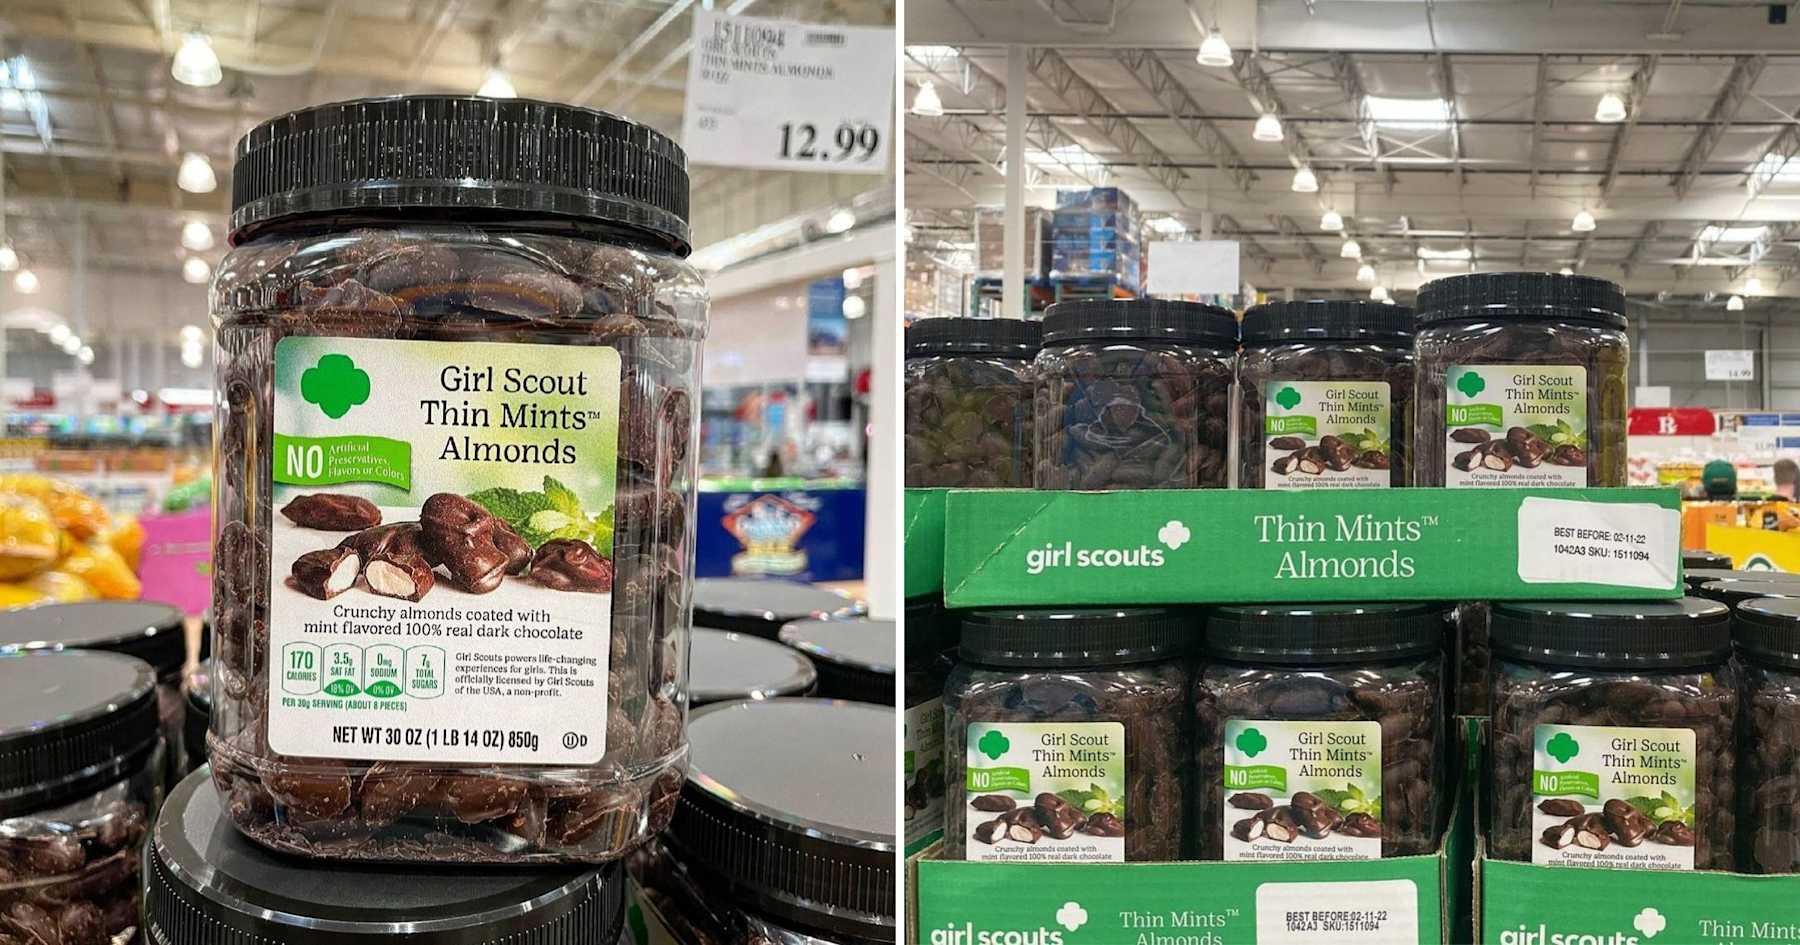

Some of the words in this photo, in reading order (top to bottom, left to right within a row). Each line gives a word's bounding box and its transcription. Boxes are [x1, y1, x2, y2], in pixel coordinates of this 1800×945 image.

[780, 122, 880, 162] 12.99
[440, 365, 492, 392] Girl
[503, 368, 587, 396] Scout
[1513, 375, 1535, 386] Girl
[1539, 375, 1573, 386] Scout
[1326, 389, 1345, 399] Girl
[1348, 390, 1379, 400] Scout
[1505, 389, 1534, 400] Thin
[420, 400, 489, 427] Thin
[1319, 402, 1344, 412] Thin
[1513, 403, 1570, 414] Almonds
[1326, 415, 1376, 424] Almonds
[1452, 408, 1467, 422] NO
[1271, 420, 1285, 431] NO
[329, 441, 369, 455] Artificial
[439, 437, 576, 464] Almonds
[287, 444, 323, 478] NO
[329, 455, 390, 466] Preservatives,
[329, 466, 360, 478] Flavors
[361, 467, 374, 475] or
[375, 467, 404, 480] Colors
[1254, 515, 1326, 542] Thin
[1554, 527, 1575, 538] BEST
[1578, 530, 1612, 541] BEFORE:
[1614, 533, 1646, 544] 02-11-22
[1027, 542, 1071, 575] girl
[1077, 544, 1165, 567] scouts
[1554, 544, 1586, 556] 1042A3
[1588, 547, 1610, 558] SKU:
[1613, 549, 1649, 561] 1511094
[1274, 550, 1415, 579] Almonds
[333, 605, 396, 621] Crunchy
[400, 606, 462, 621] almonds
[466, 608, 513, 622] coated
[516, 608, 551, 622] with
[304, 621, 338, 634] mint
[341, 620, 401, 635] flavored
[406, 623, 442, 637] 100%
[446, 624, 473, 637] real
[476, 624, 509, 638] dark
[514, 625, 583, 640] chocolate
[290, 651, 313, 669] 170
[377, 653, 392, 667] 0mg
[455, 652, 472, 661] Girl
[473, 653, 503, 662] Scouts
[504, 655, 537, 663] powers
[538, 654, 597, 666] life-changing
[330, 667, 342, 676] SAT
[344, 667, 355, 677] FAT
[370, 667, 397, 678] SODIUM
[416, 669, 434, 679] TOTAL
[455, 664, 508, 674] experiences
[510, 664, 522, 673] for
[524, 665, 546, 675] girls.
[548, 665, 568, 675] This
[570, 666, 577, 675] is
[287, 671, 317, 682] CALORIES
[455, 674, 494, 685] officially
[496, 675, 532, 684] licensed
[534, 676, 544, 687] by
[547, 677, 563, 686] Girl
[565, 677, 594, 686] Scouts
[411, 679, 438, 689] SUGARS
[455, 686, 464, 694] of
[466, 686, 480, 694] the
[483, 687, 504, 696] USA,
[514, 688, 562, 698] non-profit.
[282, 697, 296, 707] PER
[312, 700, 343, 710] SERVING
[345, 700, 372, 710] (ABOUT
[373, 701, 378, 710] 8
[380, 701, 407, 712] PIECES)
[333, 726, 357, 743] NET
[362, 727, 382, 744] WT
[386, 728, 401, 745] 30
[405, 728, 422, 745] OZ
[426, 728, 438, 750] (1
[443, 729, 459, 746] LB
[463, 730, 478, 746] 14
[483, 730, 504, 751] OZ)
[509, 731, 539, 751] 850g
[1041, 734, 1065, 746] Girl
[1070, 734, 1109, 746] Scout
[1298, 732, 1323, 745] Girl
[1327, 733, 1366, 745] Scout
[1611, 739, 1637, 751] Girl
[1641, 739, 1680, 752] Scout
[1032, 750, 1065, 762] Thin
[1289, 748, 1321, 761] Thin
[1602, 755, 1636, 767] Thin
[1042, 766, 1105, 777] Almonds
[1230, 770, 1247, 785] NO
[1299, 765, 1362, 777] Almonds
[972, 772, 990, 787] NO
[1540, 775, 1557, 792] NO
[1611, 771, 1676, 785] Almonds
[1562, 851, 1592, 859] Crunchy
[1594, 852, 1624, 860] almonds
[1119, 911, 1164, 928] Thin
[1287, 911, 1309, 922] BEST
[1287, 921, 1318, 932] 1042A3
[1698, 919, 1744, 938] Thin
[931, 922, 973, 945] girl
[978, 927, 1063, 945] scouts
[1137, 932, 1223, 945] Almonds
